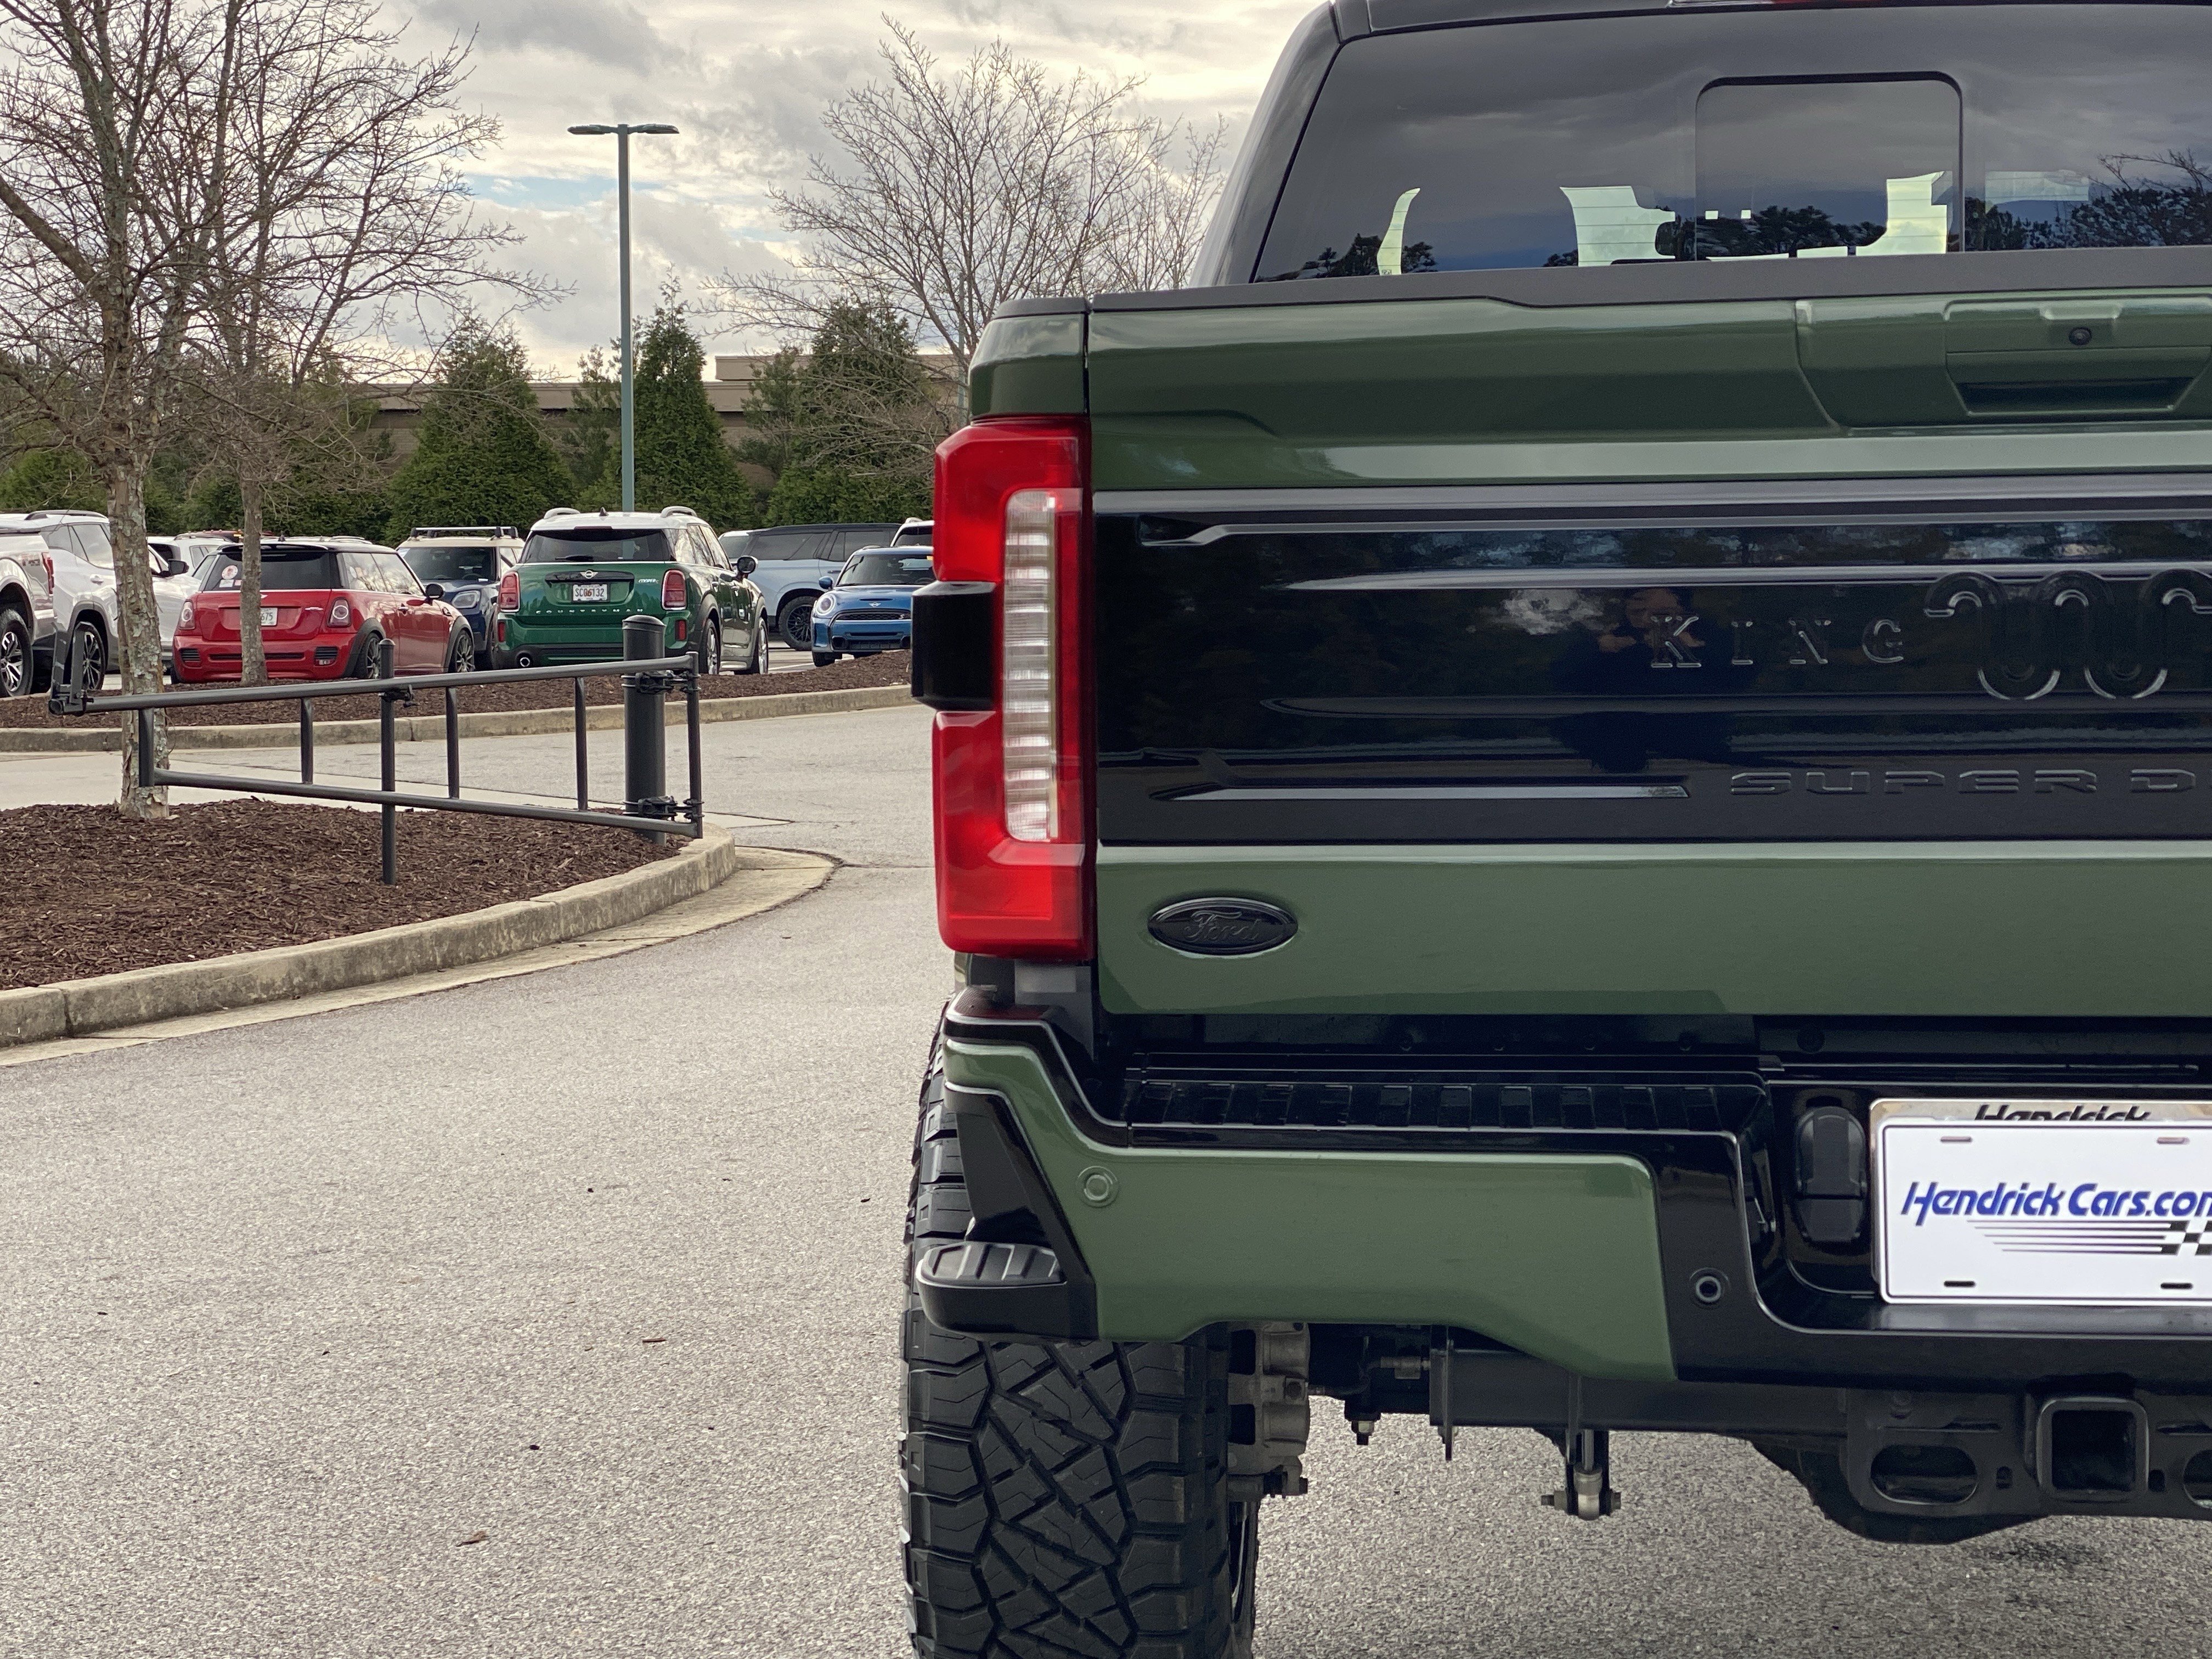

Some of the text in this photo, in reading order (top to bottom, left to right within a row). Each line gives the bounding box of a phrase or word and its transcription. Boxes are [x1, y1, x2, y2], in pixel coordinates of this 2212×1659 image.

[261, 612, 274, 621] 675
[1650, 614, 1904, 668] KING
[1731, 769, 2212, 795] SUPER D
[1184, 910, 1262, 943] Ford
